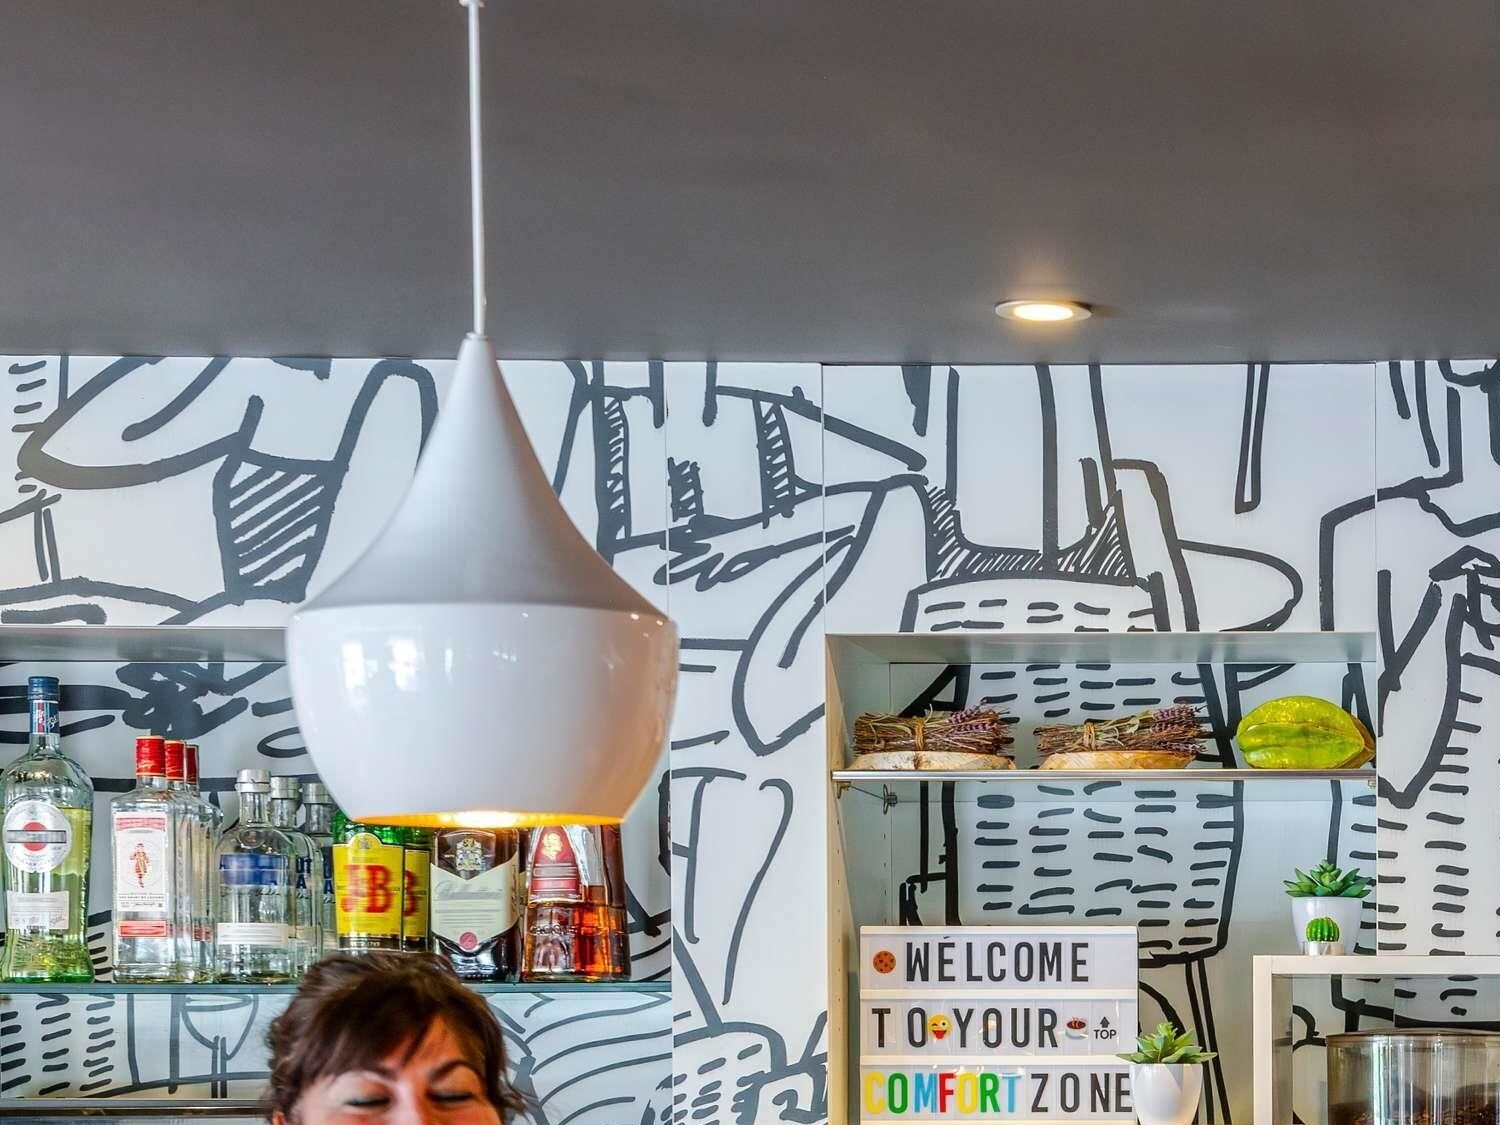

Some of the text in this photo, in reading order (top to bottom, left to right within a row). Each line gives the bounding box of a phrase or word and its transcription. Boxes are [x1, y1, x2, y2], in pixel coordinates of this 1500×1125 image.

[871, 1006, 1117, 1049] TO YOUR TOP
[863, 1072, 1133, 1115] COMFORT ZONE
